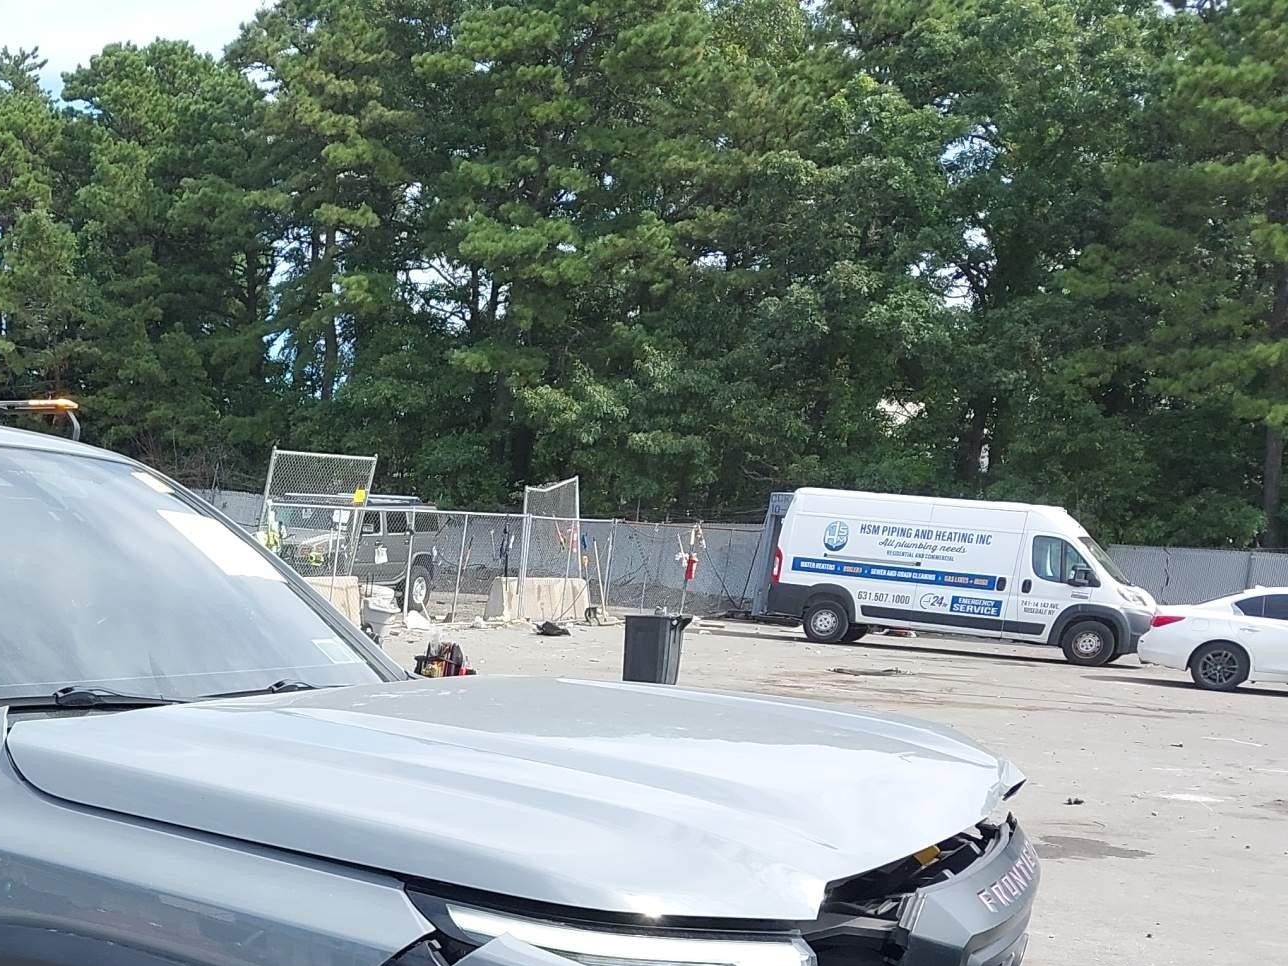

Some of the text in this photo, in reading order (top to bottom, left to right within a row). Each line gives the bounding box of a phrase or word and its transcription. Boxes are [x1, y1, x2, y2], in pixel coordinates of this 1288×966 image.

[860, 523, 992, 545] HSM PIPING AND HEATING INC
[857, 590, 911, 604] 631.507.1000
[952, 603, 999, 615] SERVICE
